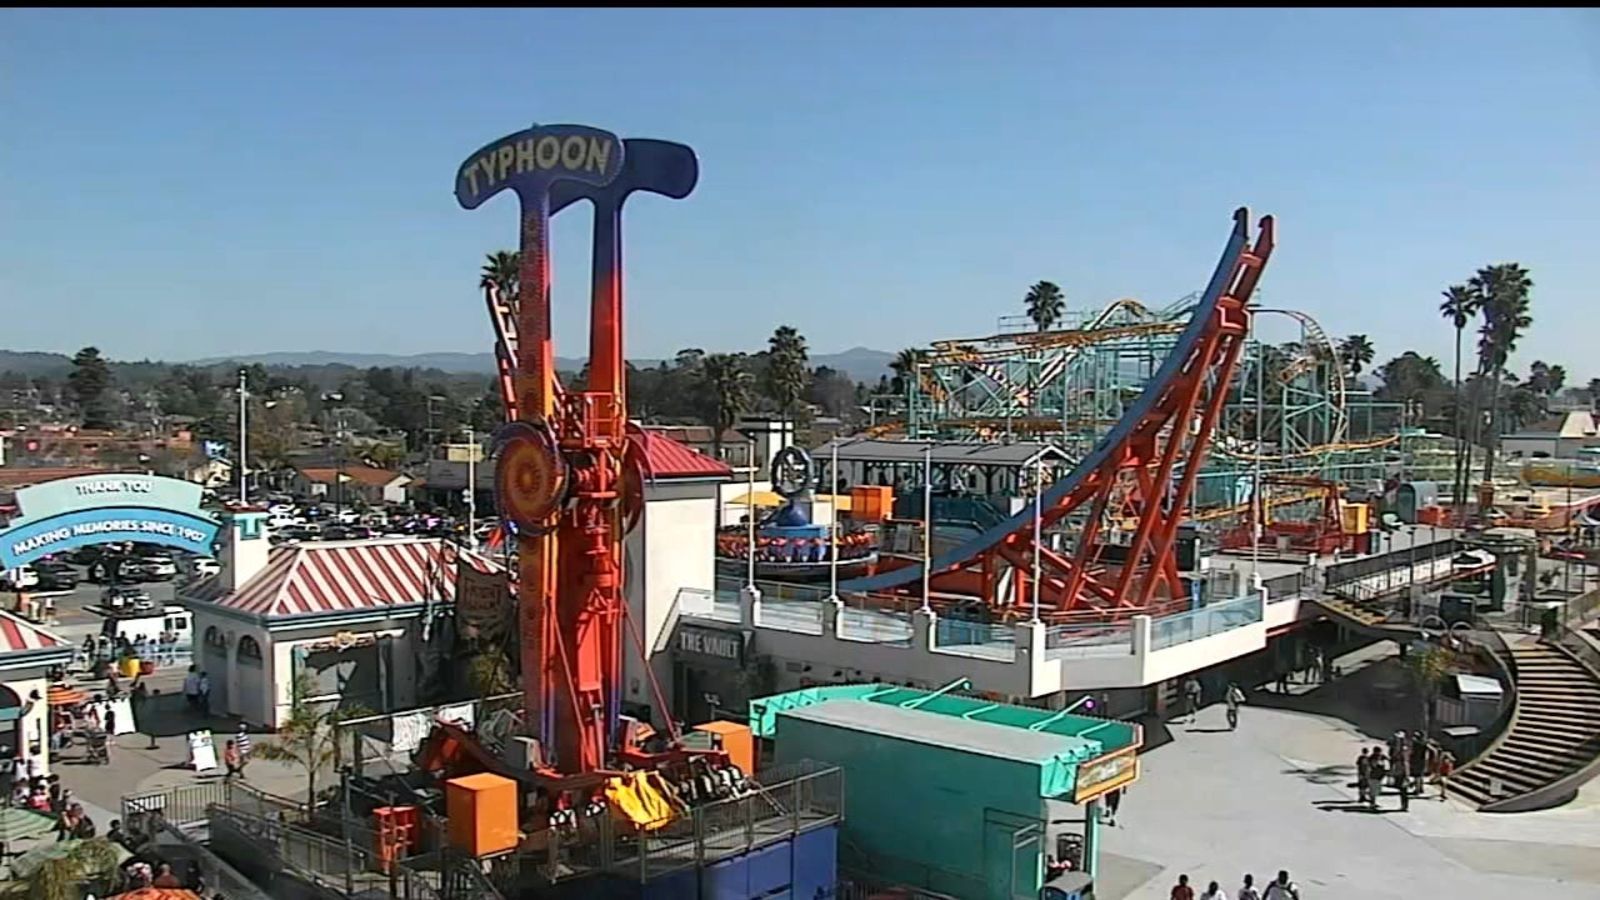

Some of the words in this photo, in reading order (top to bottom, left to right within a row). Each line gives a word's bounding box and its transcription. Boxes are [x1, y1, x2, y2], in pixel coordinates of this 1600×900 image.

[463, 135, 612, 197] TYPHOON
[76, 480, 121, 496] THANK
[123, 480, 152, 494] YOU
[13, 526, 71, 555] MAKING
[73, 519, 140, 536] MEMORIES
[141, 520, 175, 536] SINCE
[177, 526, 207, 543] 1907
[680, 631, 702, 652] THE
[703, 635, 739, 659] VAULT
